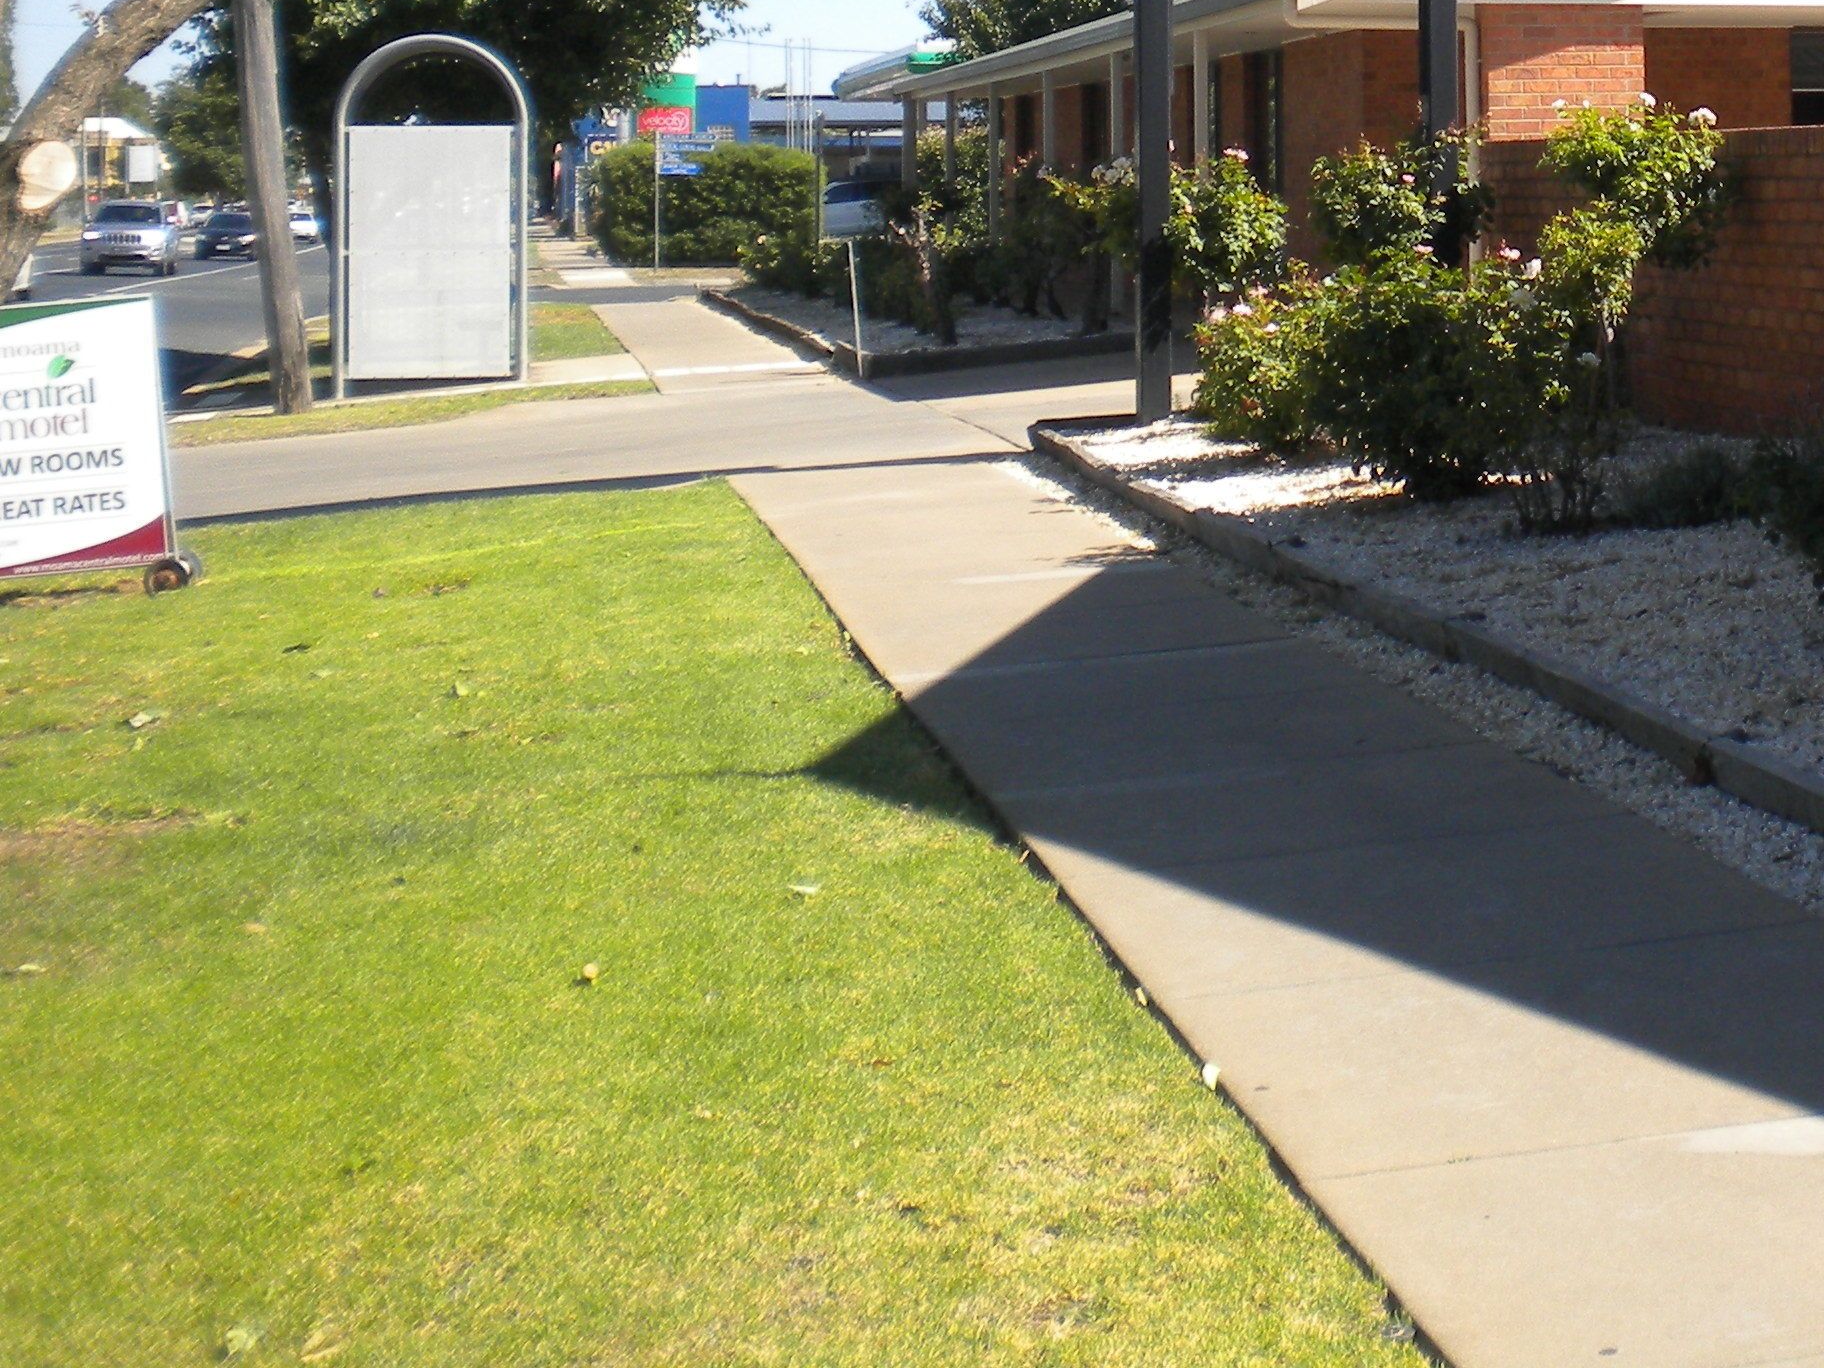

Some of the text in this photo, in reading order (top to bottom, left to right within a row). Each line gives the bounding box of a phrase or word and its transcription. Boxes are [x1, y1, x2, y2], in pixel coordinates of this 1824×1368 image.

[0, 377, 96, 411] entral
[0, 408, 88, 441] motel
[30, 447, 125, 474] ROOMS
[0, 490, 126, 520] EAT RATES
